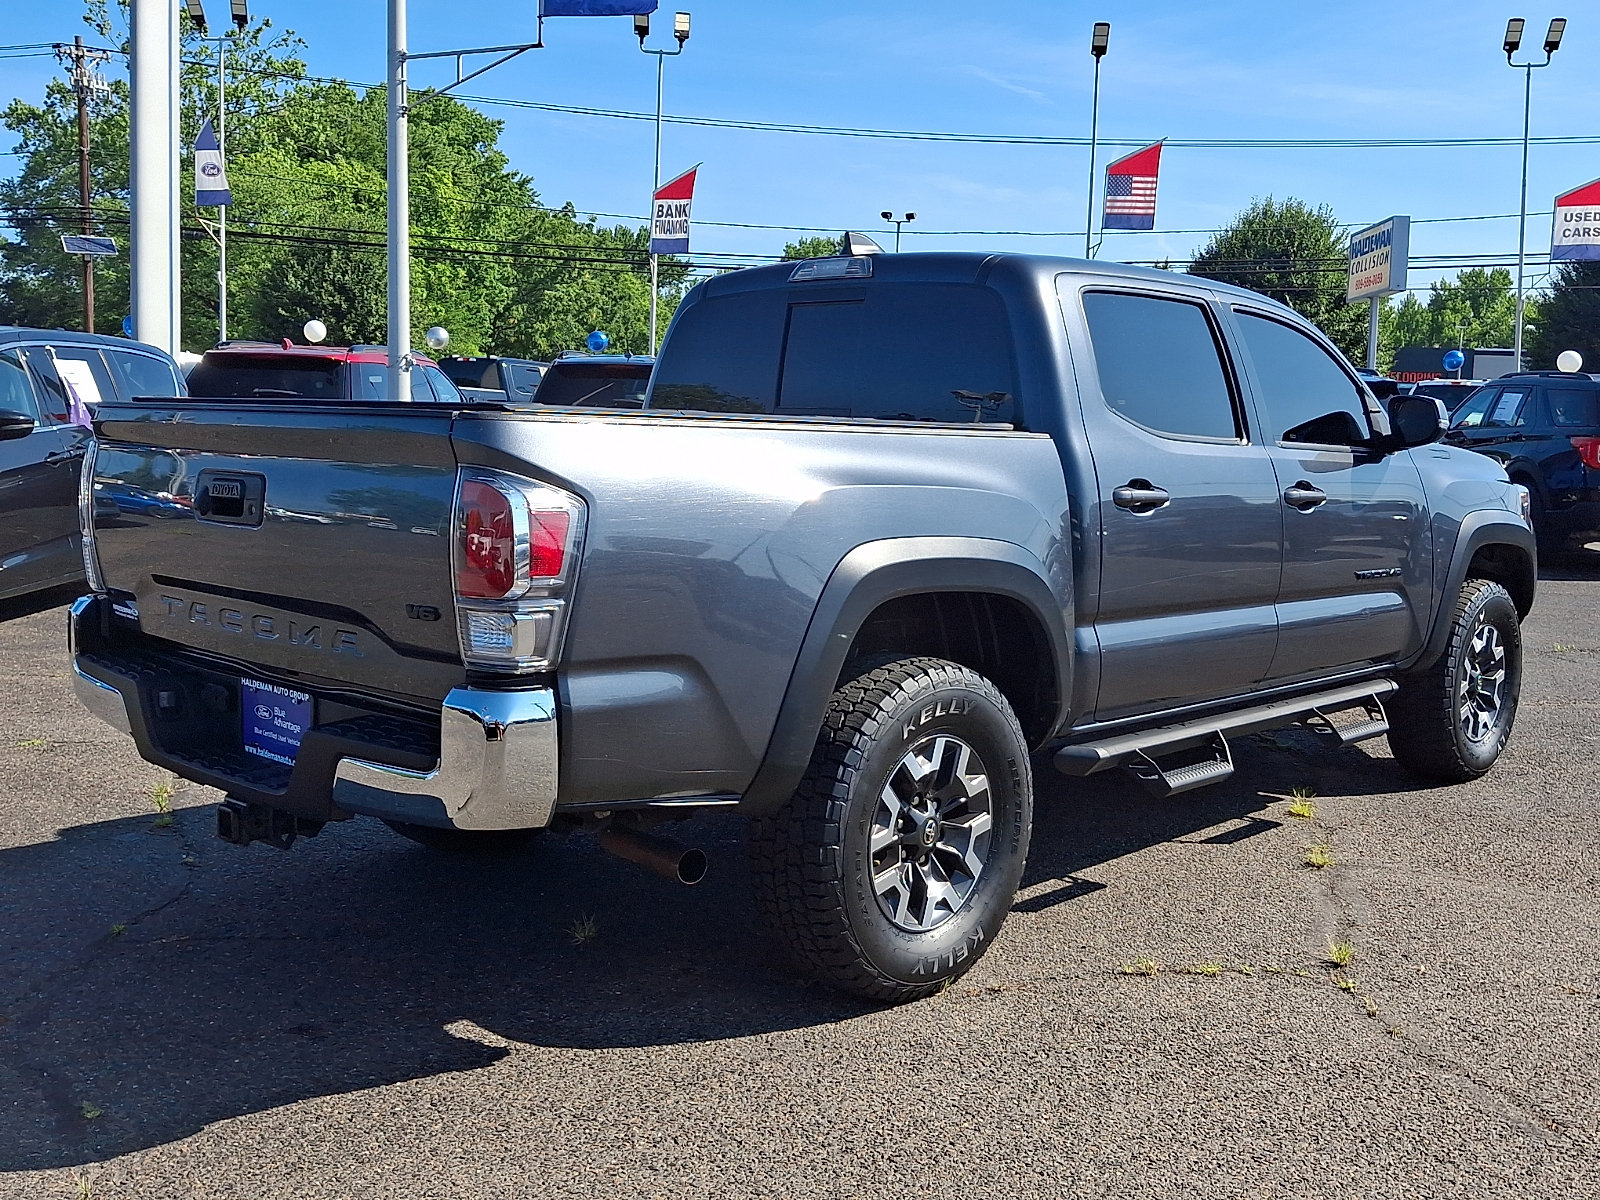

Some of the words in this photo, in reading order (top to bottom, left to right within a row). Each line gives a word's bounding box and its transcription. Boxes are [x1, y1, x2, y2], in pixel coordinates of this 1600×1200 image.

[656, 203, 690, 219] BANK
[1563, 211, 1600, 223] USED
[1562, 227, 1600, 238] CARS
[1351, 227, 1392, 260] HALDEMAN
[1351, 250, 1390, 276] COLLISION
[210, 483, 239, 496] TOYOTA
[405, 603, 442, 622] V6
[160, 594, 364, 658] TACOMA
[241, 677, 273, 693] HALDEMAN
[273, 685, 289, 697] AUTO
[289, 689, 309, 702] GROUP
[273, 706, 286, 718] Blue
[901, 697, 977, 740] KELLY
[273, 717, 301, 734] Advantage
[911, 921, 985, 975] KELLY
